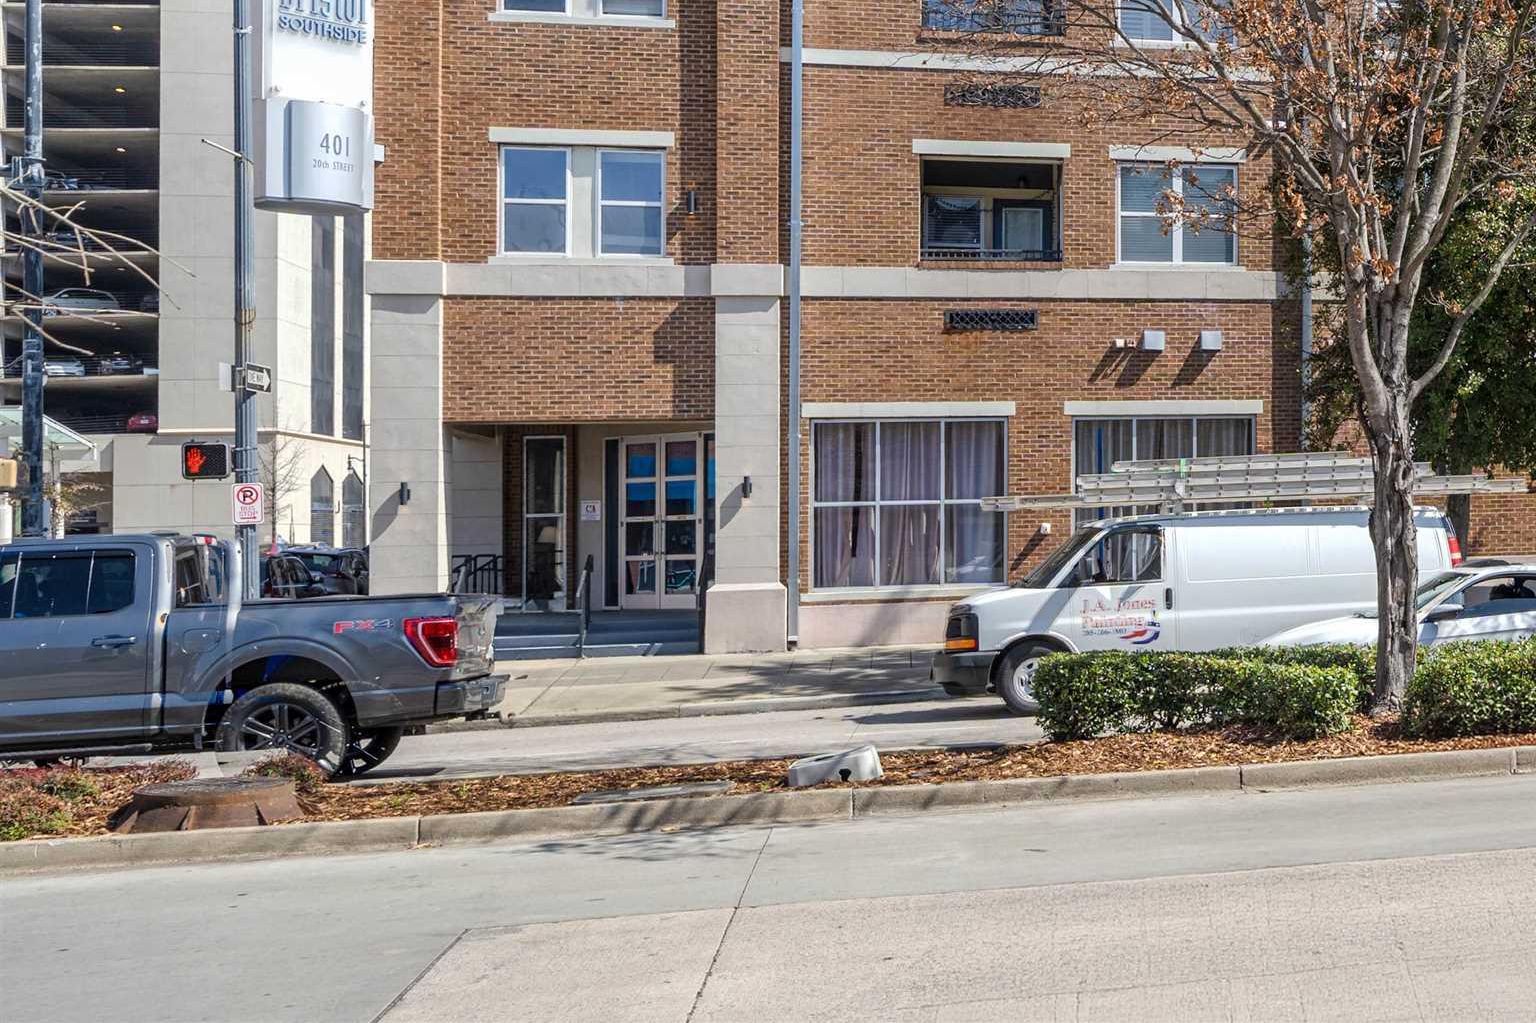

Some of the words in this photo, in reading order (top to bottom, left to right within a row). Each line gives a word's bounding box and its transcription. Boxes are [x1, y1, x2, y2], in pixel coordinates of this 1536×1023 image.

[279, 16, 366, 44] SOUTHSIDE
[320, 133, 349, 157] 401
[312, 158, 329, 169] 20th
[1115, 598, 1157, 612] Jones
[333, 618, 395, 634] FX4
